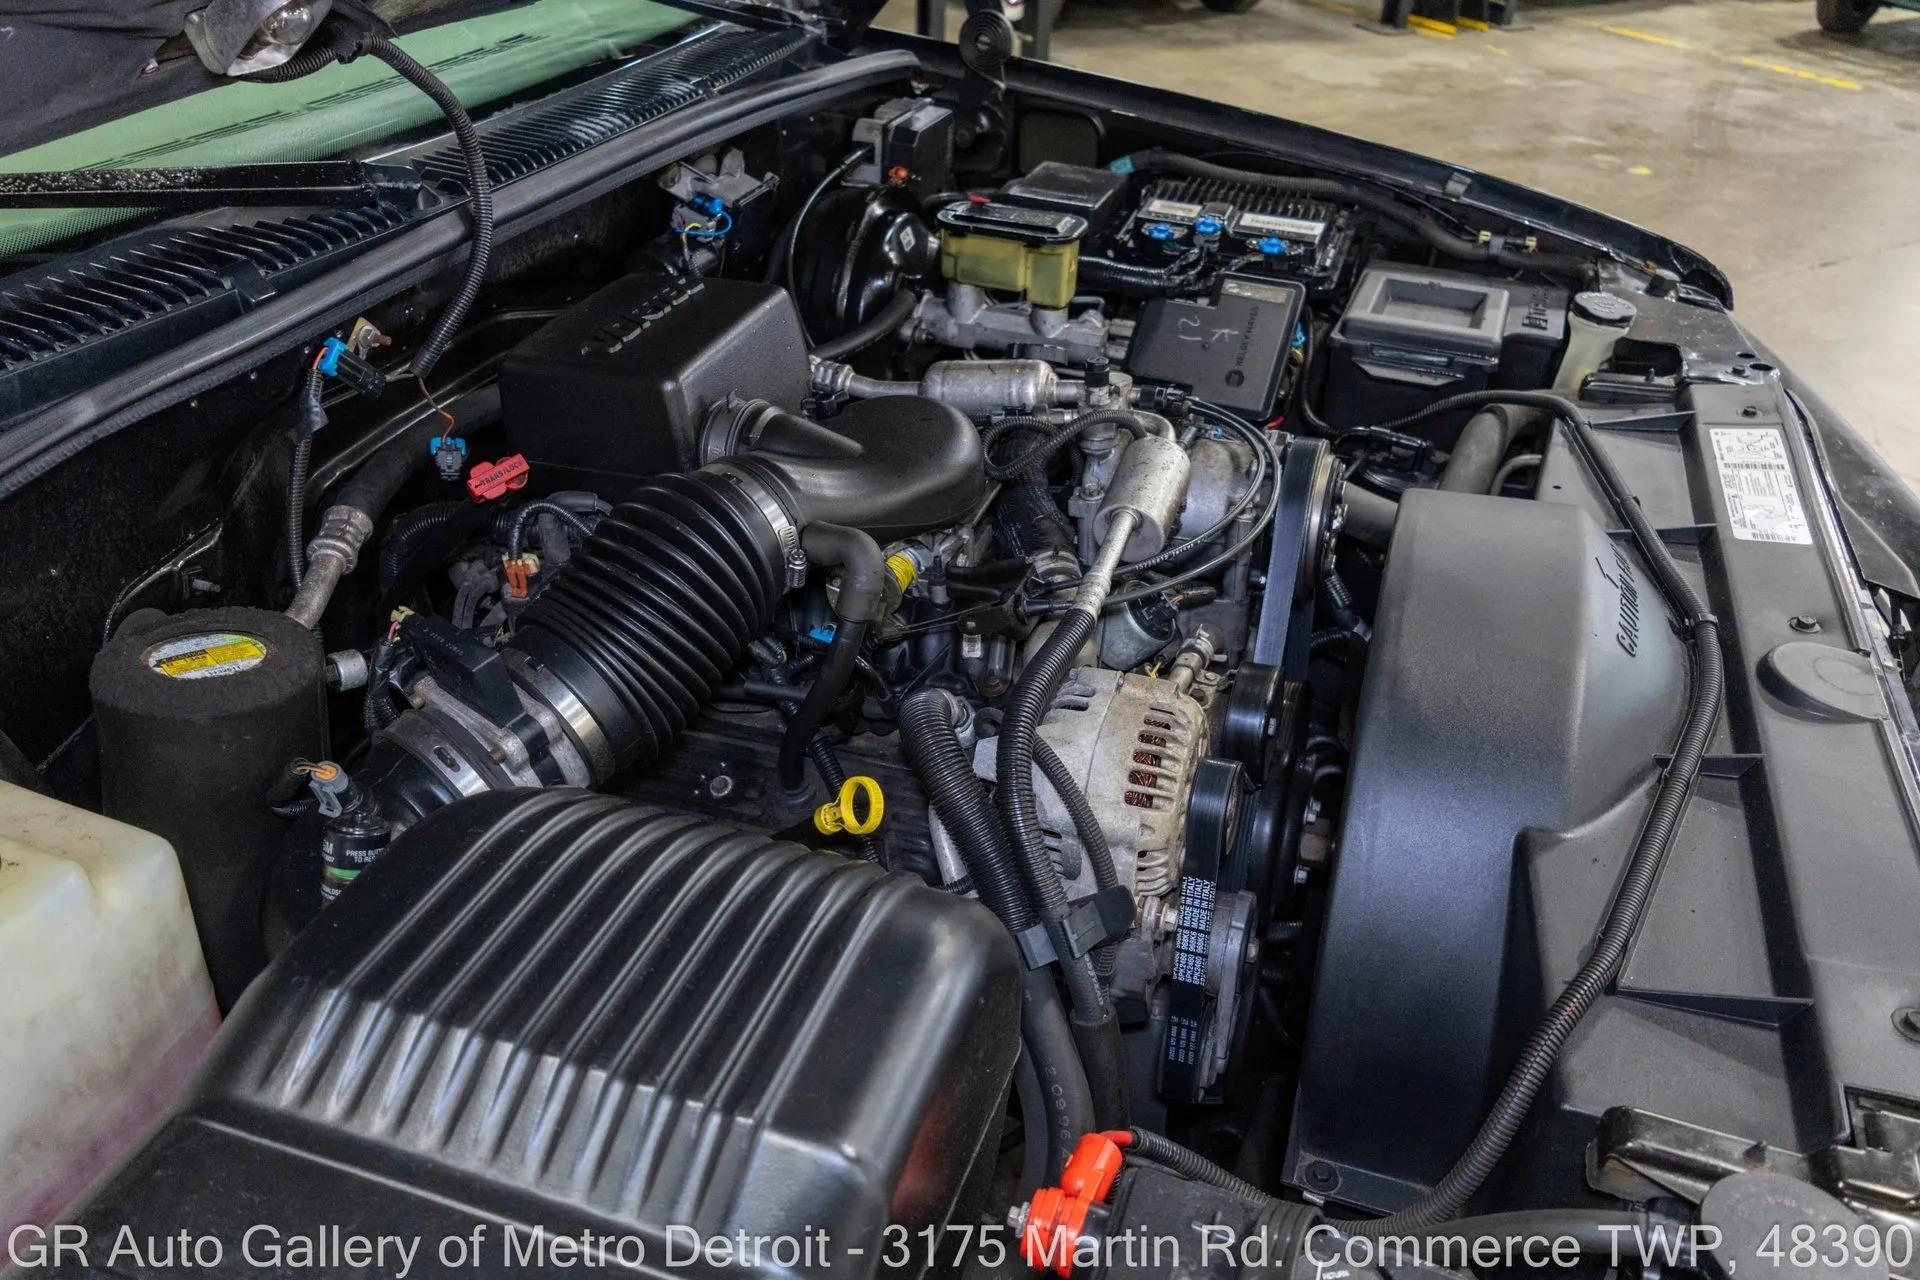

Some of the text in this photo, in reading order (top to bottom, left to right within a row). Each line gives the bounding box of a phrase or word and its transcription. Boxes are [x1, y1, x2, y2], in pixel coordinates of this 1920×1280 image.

[1616, 573, 1639, 658] CAUTION
[345, 849, 367, 857] PRESS
[1186, 876, 1195, 897] ITALY
[1194, 878, 1203, 899] ITALY
[1201, 880, 1211, 901] ITALY
[1186, 897, 1194, 905] IN
[1193, 899, 1201, 907] IN
[1201, 900, 1209, 908] IN
[1183, 905, 1192, 927] MADE
[1191, 907, 1200, 929] MADE
[1198, 908, 1208, 930] MADE
